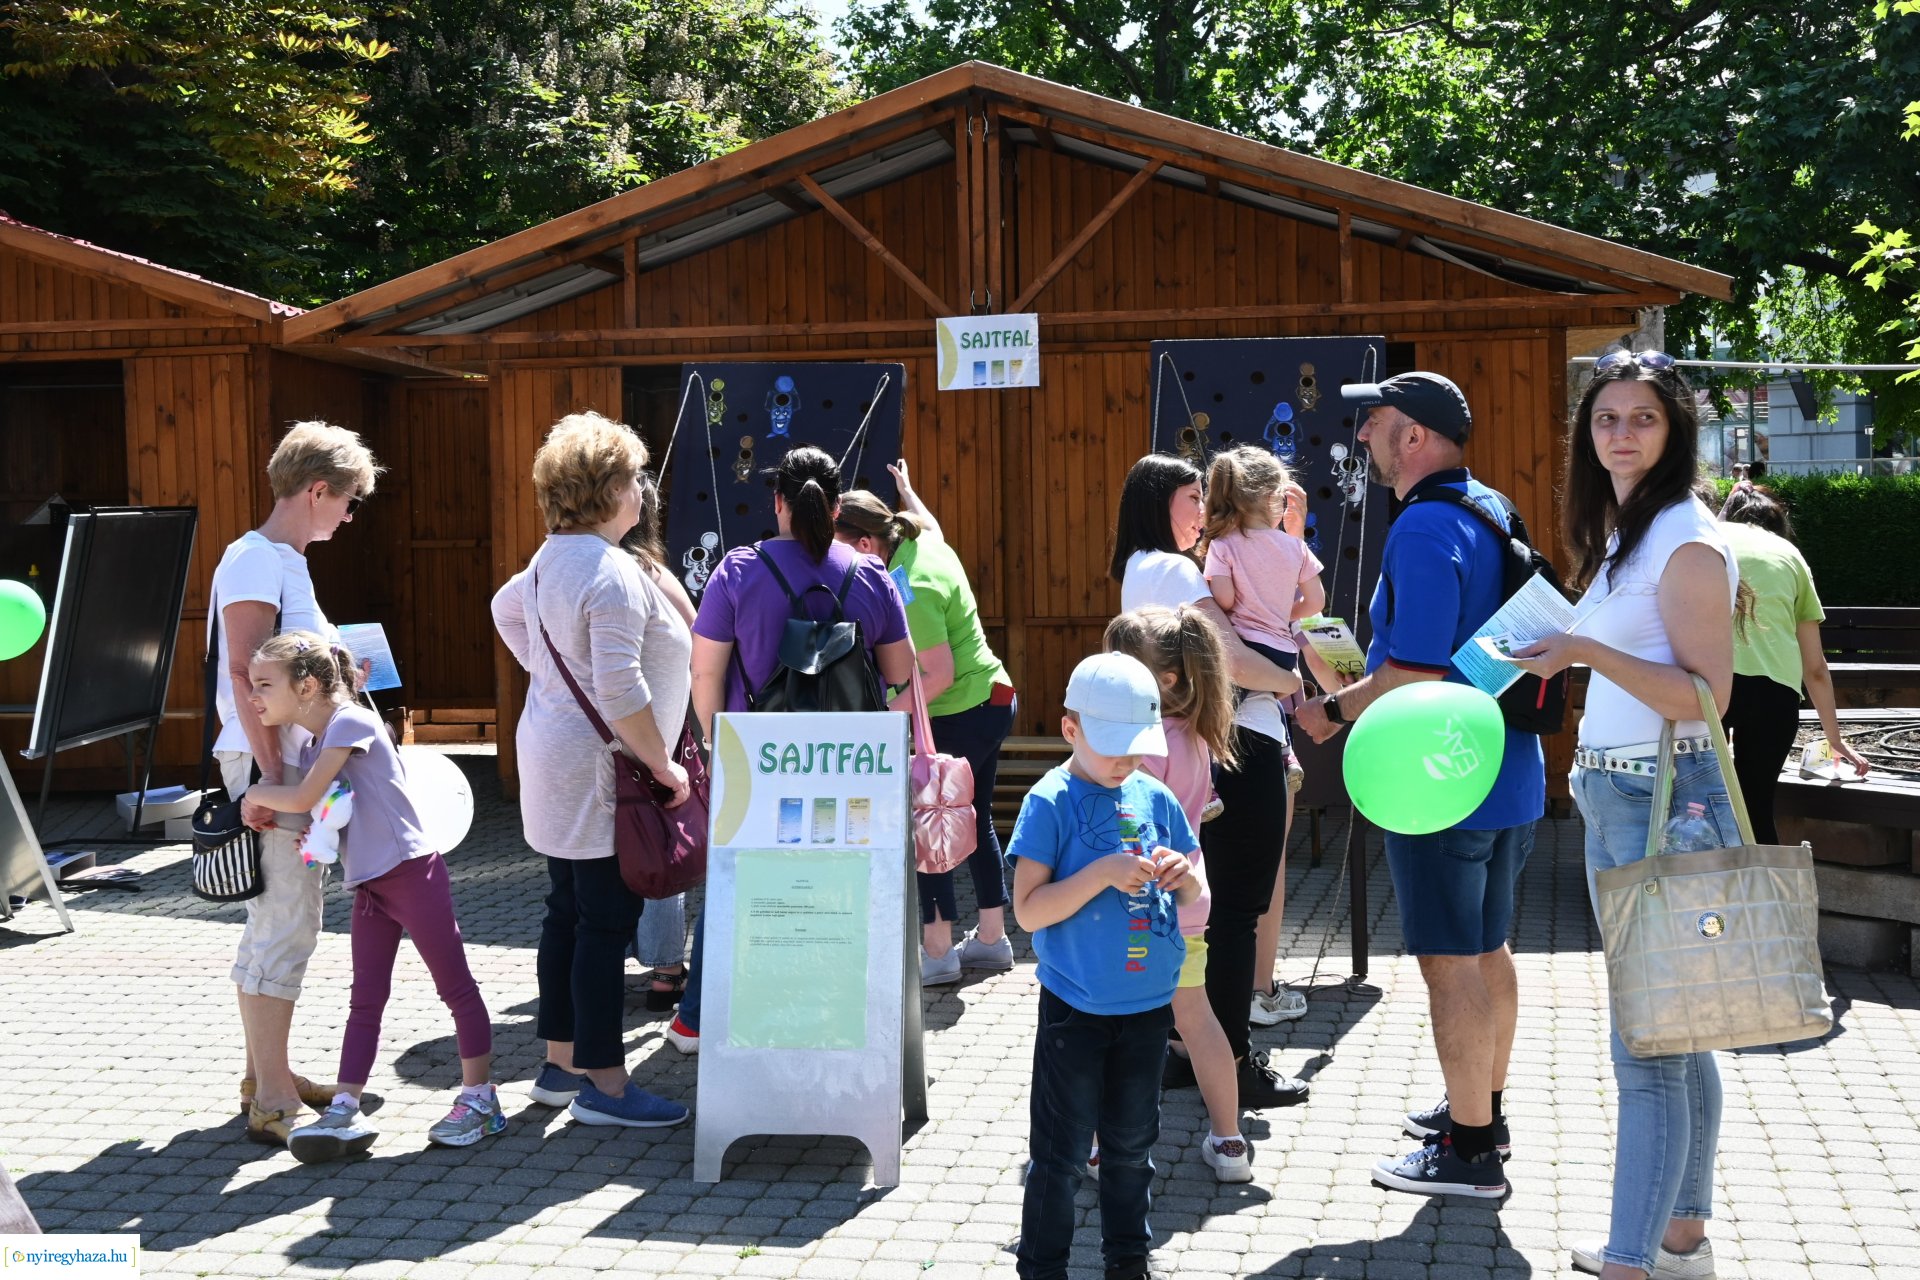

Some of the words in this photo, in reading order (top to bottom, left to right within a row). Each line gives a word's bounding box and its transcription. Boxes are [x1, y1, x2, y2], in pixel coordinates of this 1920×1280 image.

[960, 330, 1033, 350] SAJTFAL
[758, 742, 893, 775] SAJTFAL
[1432, 718, 1479, 778] EAK
[1114, 801, 1143, 854] LIMIT
[1125, 918, 1151, 972] PUSH
